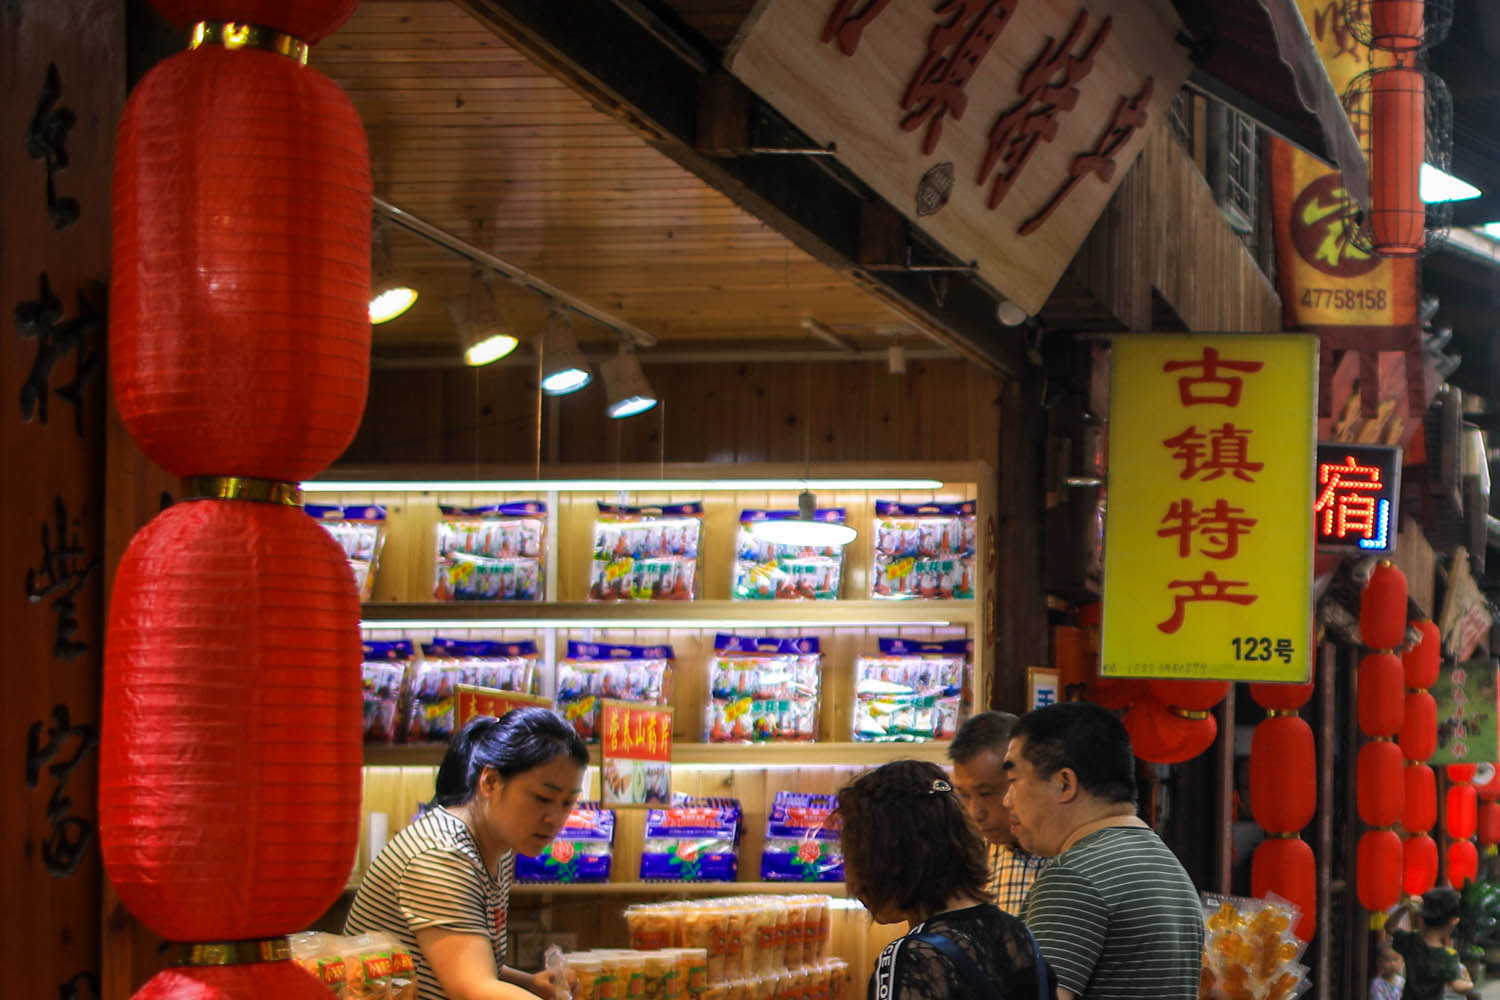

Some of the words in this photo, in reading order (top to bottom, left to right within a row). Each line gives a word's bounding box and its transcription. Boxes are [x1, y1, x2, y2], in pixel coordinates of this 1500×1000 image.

[821, 0, 1155, 236] 镇特产
[1300, 287, 1387, 310] 47758158
[1157, 346, 1265, 635] 古镇特产
[1314, 455, 1382, 538] 宿
[1232, 637, 1295, 664] 123号
